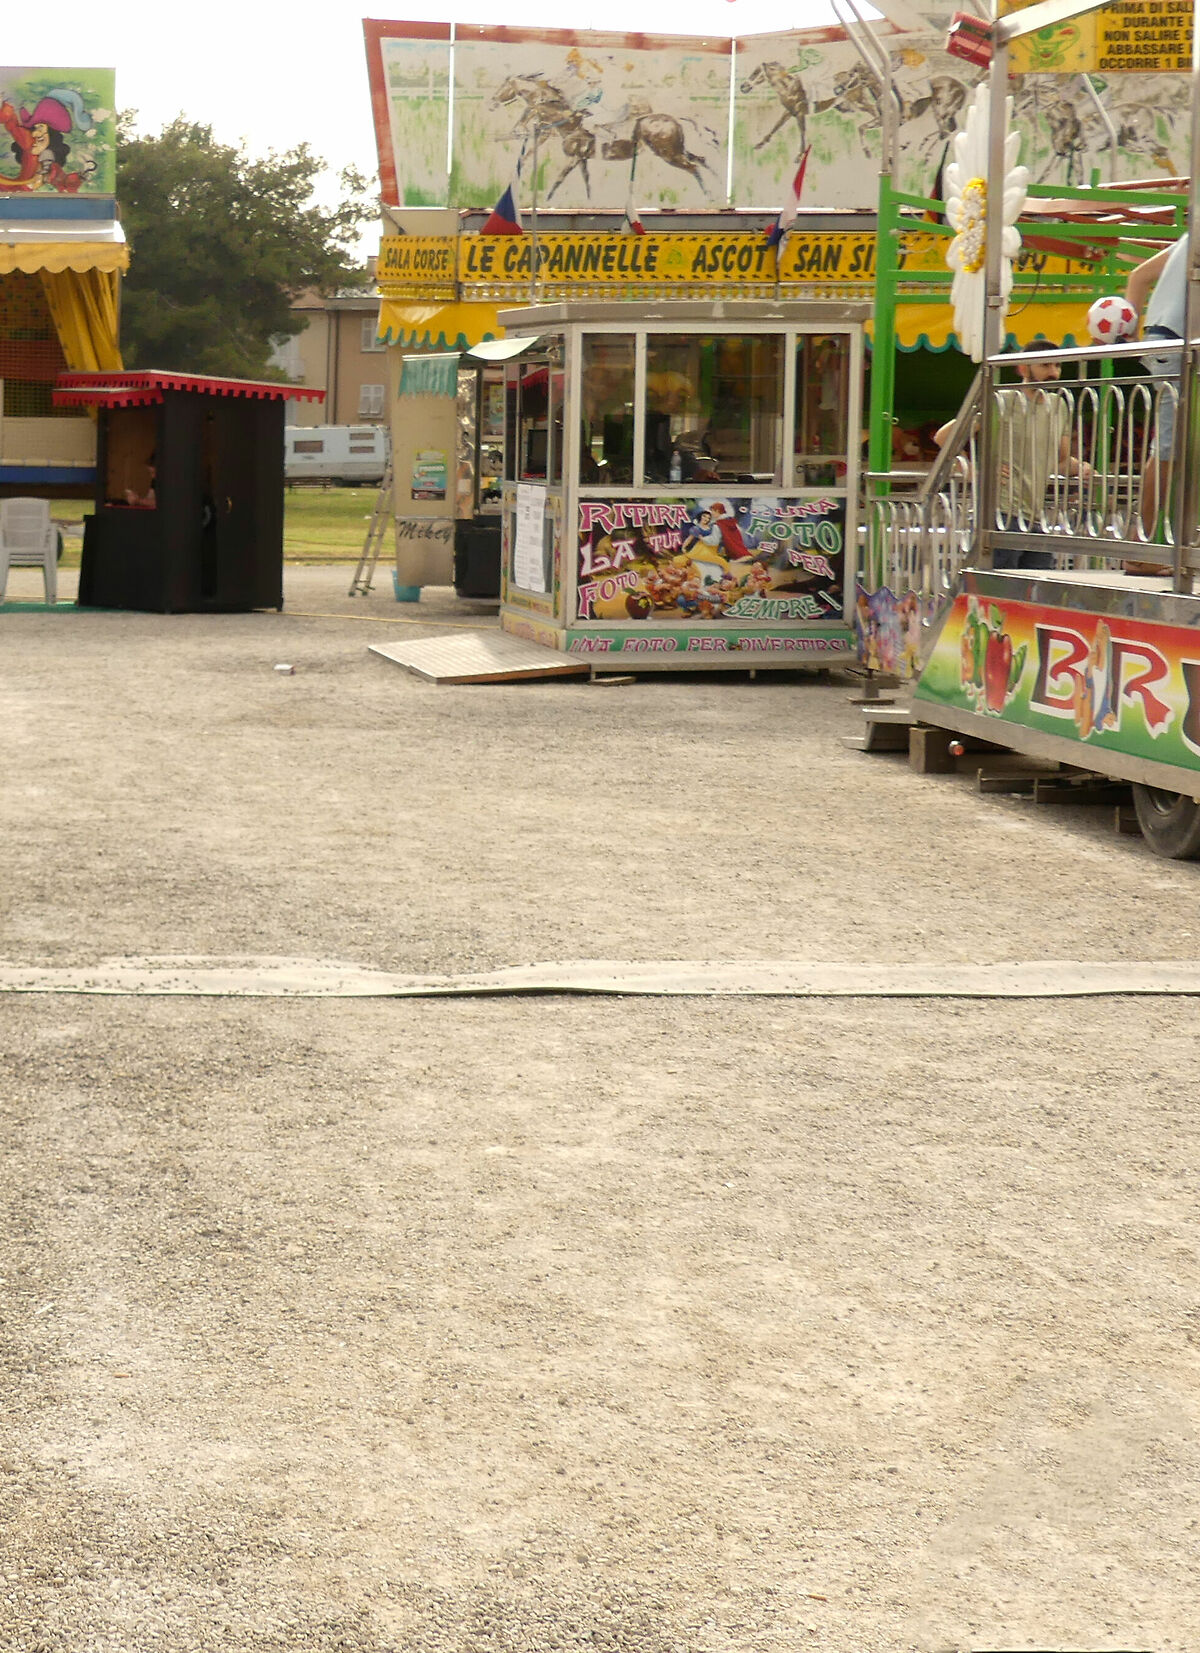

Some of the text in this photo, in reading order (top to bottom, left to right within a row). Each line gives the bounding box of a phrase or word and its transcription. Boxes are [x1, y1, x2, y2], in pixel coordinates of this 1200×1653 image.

[1149, 2, 1162, 14] DI
[1123, 16, 1184, 28] DURANTE
[1104, 30, 1131, 41] NON
[1134, 30, 1180, 41] SALIRE
[1107, 43, 1184, 55] ABBASSARE
[1099, 57, 1161, 69] OCCORRE
[384, 247, 449, 271] SALA CORSE
[467, 244, 907, 273] LE CAPANNELLE ASCOT SAN SI
[579, 503, 691, 534] RITIRA
[745, 517, 842, 555] FOTO
[580, 530, 682, 577] LA TUA
[786, 548, 835, 581] PER
[578, 570, 638, 620] FOTO
[722, 595, 825, 620] SEMPRE
[621, 636, 678, 652] FOTO
[686, 636, 729, 652] PER
